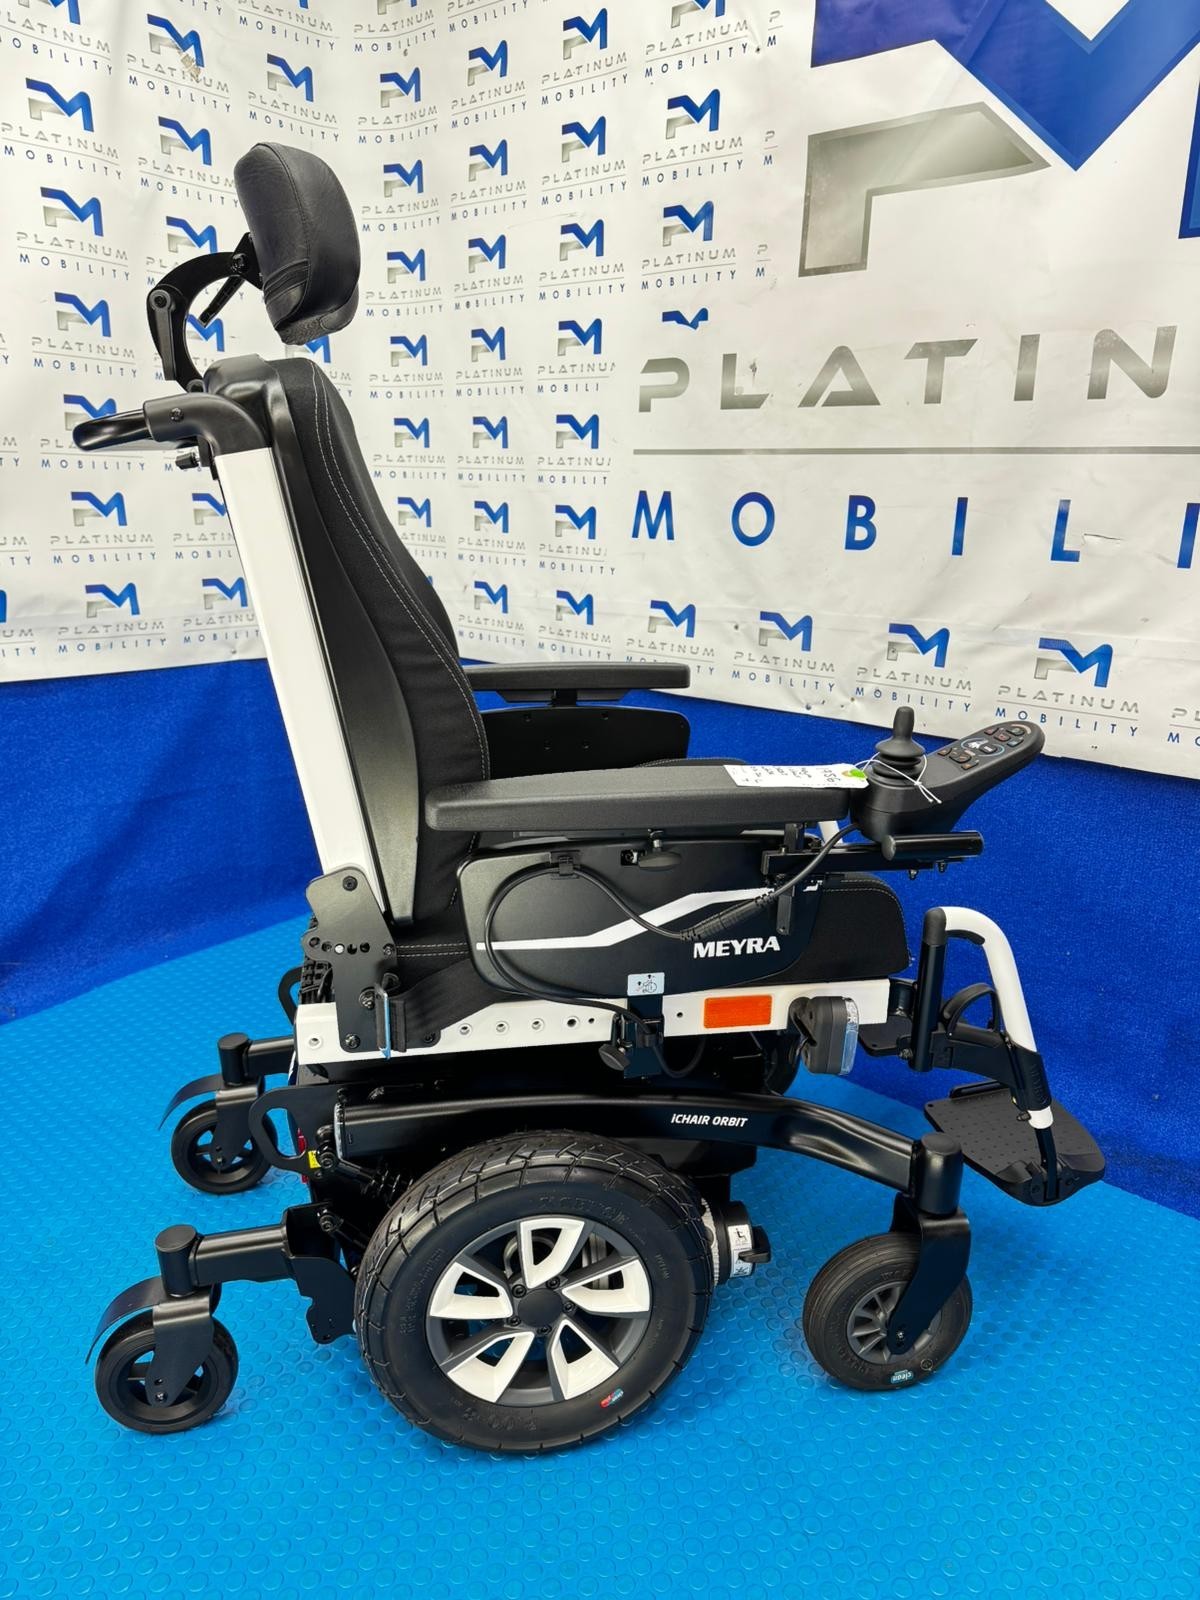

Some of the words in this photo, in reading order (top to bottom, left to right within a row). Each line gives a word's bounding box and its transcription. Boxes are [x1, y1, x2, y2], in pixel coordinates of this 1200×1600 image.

[354, 10, 434, 33] PLATINUM
[449, 0, 527, 32] MOBILITY
[0, 10, 111, 53] LATINUM
[239, 16, 334, 50] MOBILITY
[355, 30, 436, 52] MOBILITY
[646, 20, 748, 55] PLATINUM
[0, 37, 112, 75] OBILITY
[645, 43, 747, 78] MOBILITY
[541, 52, 627, 85] PLATINUM
[129, 75, 231, 112] MOBILITY
[451, 80, 526, 110] PLATINUM
[541, 73, 628, 105] MOBILITY
[248, 91, 338, 124] PLATINUM
[358, 105, 438, 125] PLATINUM
[451, 101, 527, 129] MOBILITY
[250, 111, 339, 142] MOBILITY
[358, 125, 438, 143] MOBILITY
[1, 122, 119, 158] PLATINUM
[642, 136, 743, 164] PLATINUM
[4, 145, 122, 180] MOBILITY
[541, 160, 626, 185] PLATINUM
[642, 159, 743, 186] MOBILITY
[140, 178, 238, 207] MOBILITY
[451, 180, 526, 202] PLATINUM
[541, 181, 627, 206] MOBILITY
[362, 198, 439, 214] PLATINUM
[451, 200, 527, 220] MOBILITY
[362, 216, 440, 231] MOBILITY
[17, 232, 128, 260] PLATINUM
[20, 254, 129, 281] MOBILITY
[641, 248, 736, 269] PLATINUM
[539, 263, 625, 281] PLATINUM
[641, 270, 736, 290] MOBILITY
[365, 287, 442, 299] PLATINUM
[454, 275, 523, 292] PLATINUM
[539, 284, 625, 301] MOBILITY
[366, 305, 443, 316] MOBILITY
[455, 294, 524, 310] MOBILITY
[32, 337, 134, 358] PLATINUM
[34, 358, 137, 377] MOBILITY
[369, 372, 443, 382] PLATINUM
[456, 367, 523, 380] PLATINUM
[370, 391, 444, 399] MOBILITY
[456, 385, 524, 397] MOBILITY
[41, 459, 145, 471] MOBILITY
[373, 454, 445, 464] PLATINUM
[458, 455, 524, 465] PLATINUM
[537, 456, 611, 466] PLATINU
[374, 470, 447, 480] MOBILITY
[458, 473, 525, 483] MOBILITY
[51, 535, 153, 545] PLATINUM
[458, 537, 526, 550] PLATINUM
[539, 543, 607, 556] PLATINU
[54, 551, 156, 564] MOBILITY
[458, 553, 527, 567] MOBILITY
[539, 560, 616, 575] MOBILITY
[58, 621, 164, 635] PLATINUM
[459, 614, 524, 630] PLATINUM
[459, 629, 525, 647] MOBILITY
[539, 625, 611, 643] PLATINUM
[58, 639, 166, 653] MOBILITY
[538, 641, 612, 660] MOBILITY
[626, 638, 714, 657] PLATINUM
[734, 651, 835, 672] PLATINUM
[732, 670, 835, 692] MOBILITY
[857, 667, 972, 691] PLATINUM
[855, 687, 970, 712] MOBILITY
[998, 685, 1139, 714] PLATINUM
[995, 707, 1137, 737] MOBILITY
[693, 936, 780, 959] MEYRA
[712, 1117, 748, 1127] ORBIT
